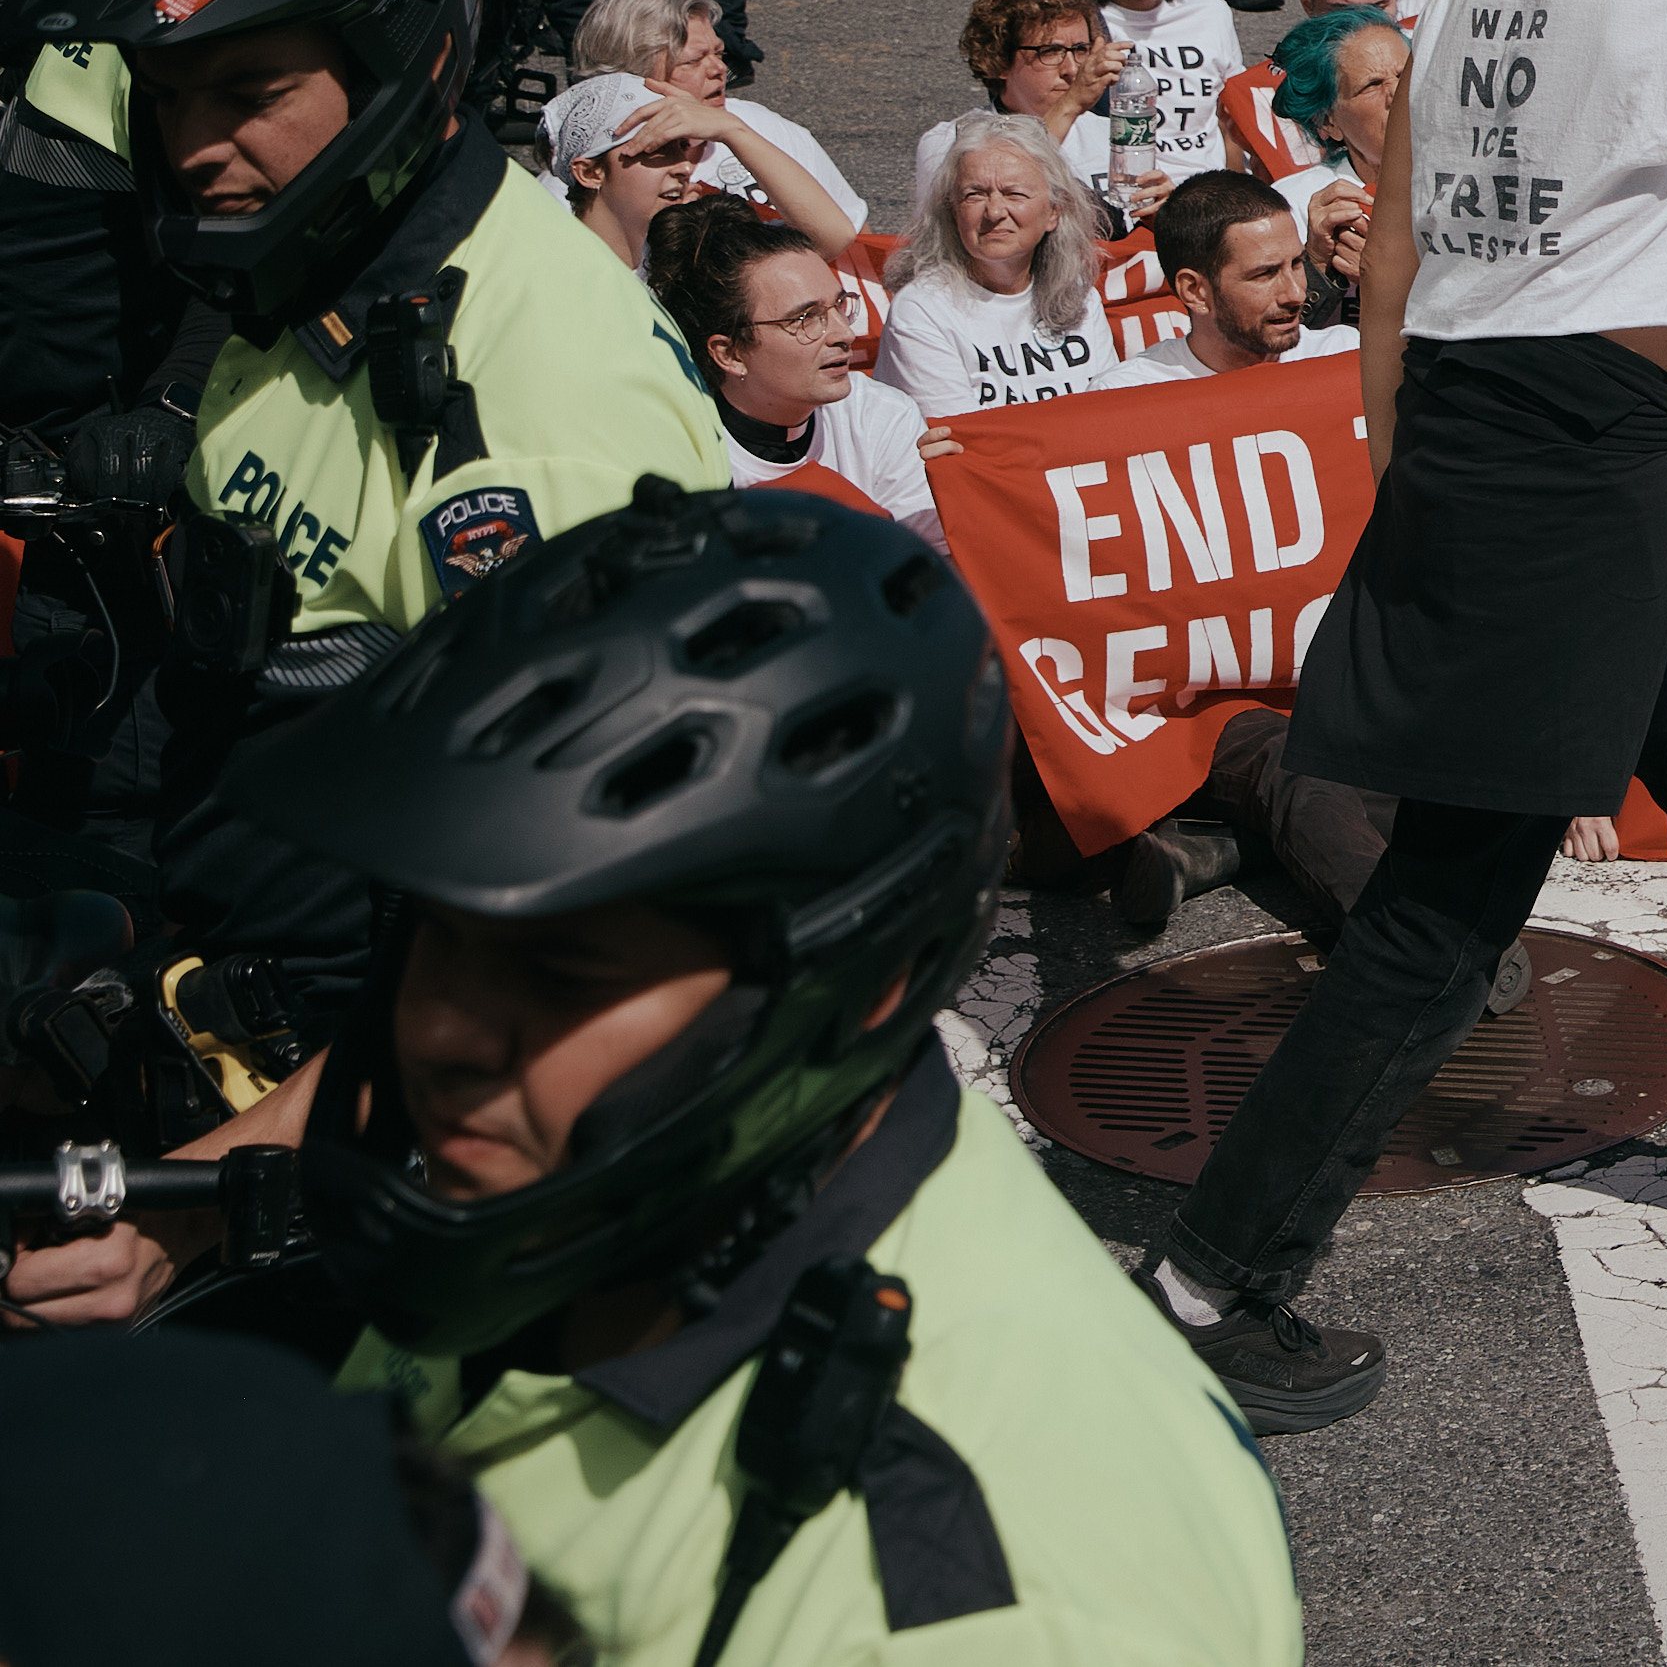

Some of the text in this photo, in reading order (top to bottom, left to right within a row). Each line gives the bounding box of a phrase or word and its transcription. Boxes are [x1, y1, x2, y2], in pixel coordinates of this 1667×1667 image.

[1470, 7, 1549, 42] WAR
[1147, 45, 1205, 70] ND
[1157, 77, 1213, 97] PLE
[1459, 56, 1537, 110] NO
[1156, 132, 1208, 153] MBS
[1470, 125, 1518, 158] ICE
[1426, 172, 1564, 226] FREE
[217, 449, 353, 590] POLICE
[438, 492, 521, 539] POLICE
[467, 523, 498, 542] NYPD
[1045, 429, 1326, 603] END
